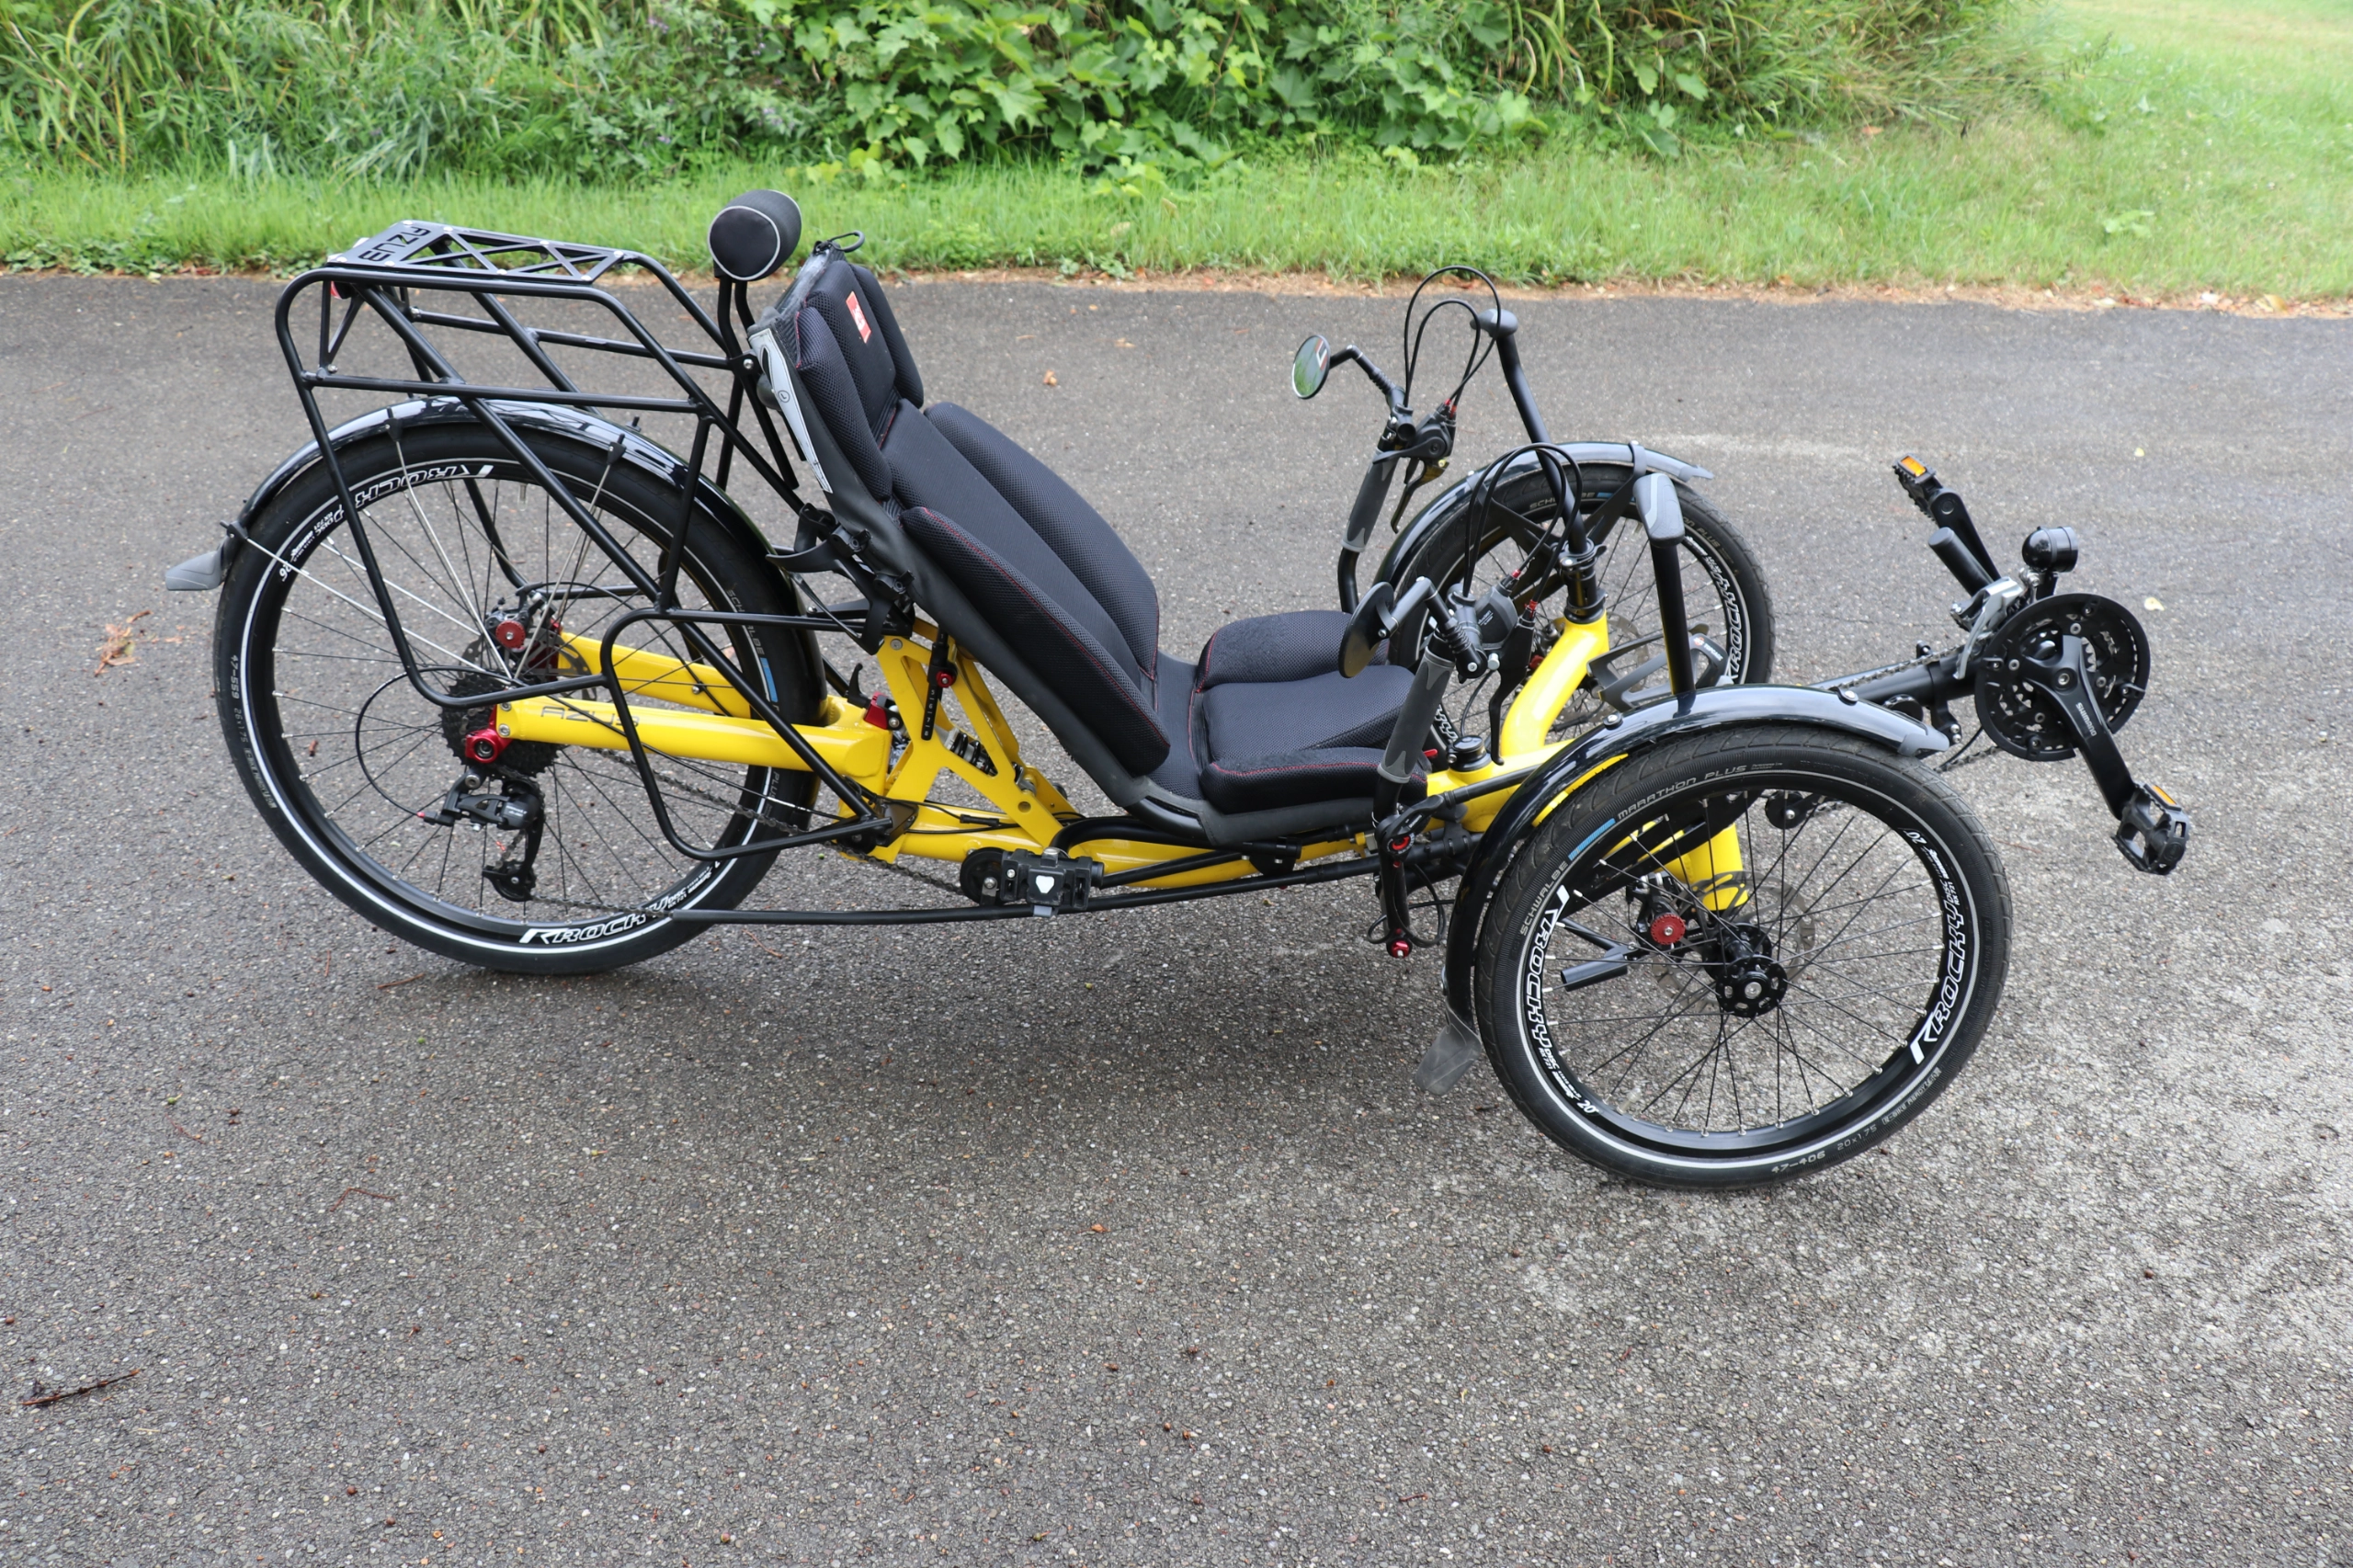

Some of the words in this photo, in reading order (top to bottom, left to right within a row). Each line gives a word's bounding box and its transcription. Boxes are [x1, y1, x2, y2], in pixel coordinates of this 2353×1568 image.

[358, 226, 431, 262] AZUB
[1529, 492, 1596, 510] SCHBE
[726, 588, 765, 655] SCHALBE
[230, 654, 240, 699] 47-559
[2075, 702, 2097, 736] SHIMANO
[1618, 777, 1697, 820] MARATHON
[1704, 765, 1747, 780] PLUS
[1519, 860, 1569, 936] SCHWALBE
[1544, 1048, 1560, 1069] DISC
[1771, 1150, 1825, 1174] 47-406
